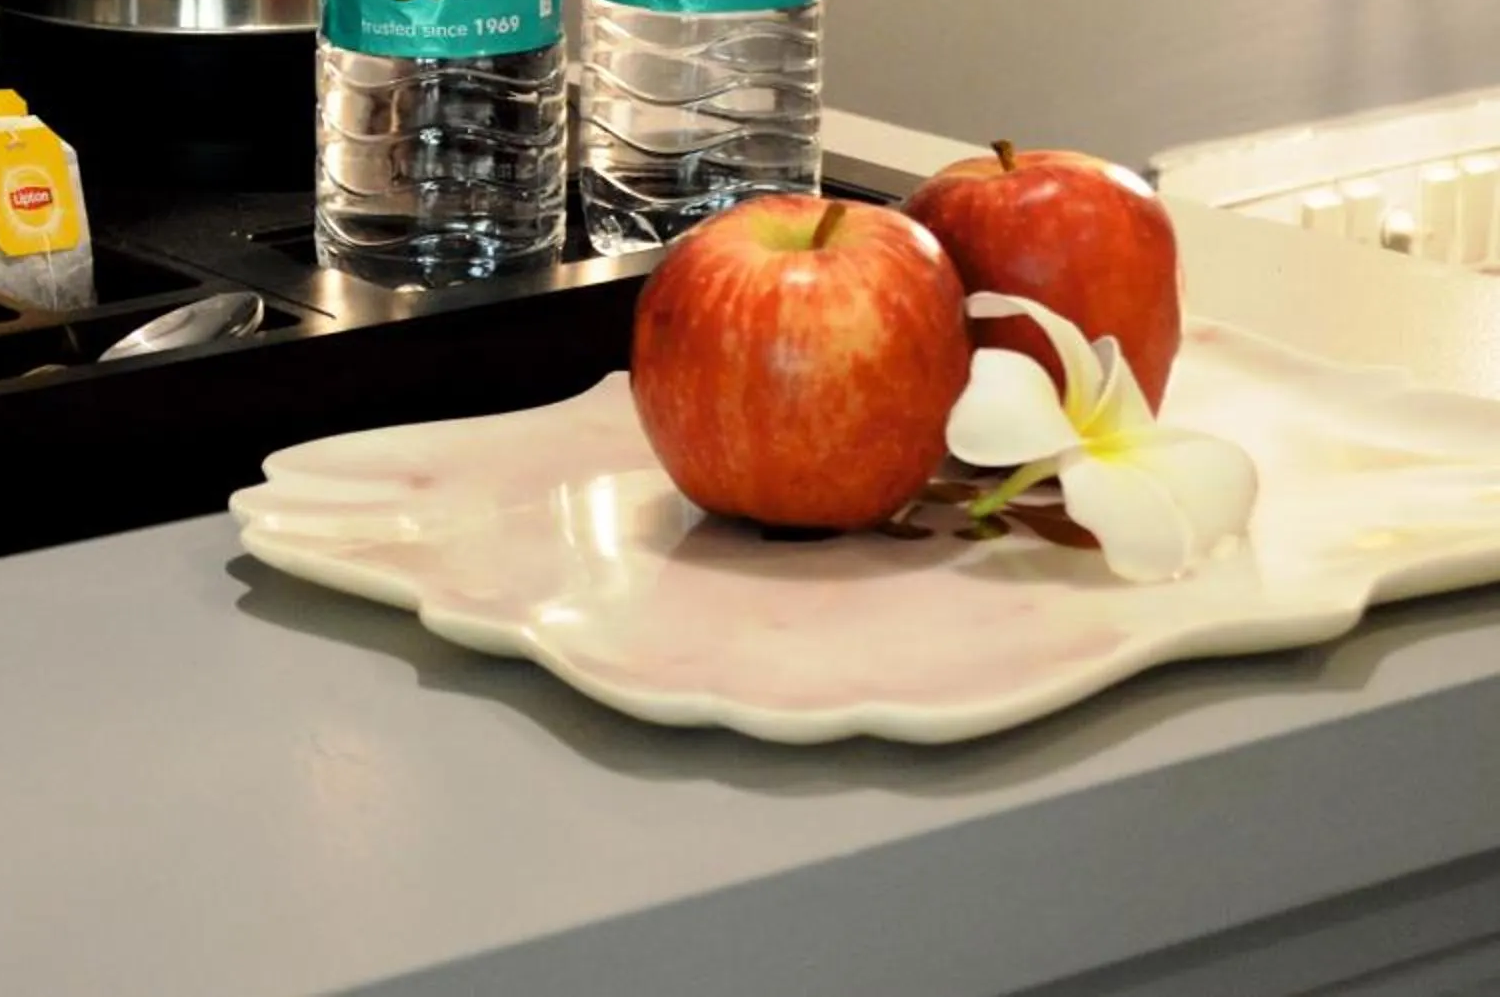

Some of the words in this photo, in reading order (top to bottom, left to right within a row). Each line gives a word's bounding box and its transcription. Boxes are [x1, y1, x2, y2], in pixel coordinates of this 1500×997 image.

[361, 17, 417, 38] trusted
[422, 22, 469, 39] since
[473, 14, 521, 36] 1969
[13, 191, 50, 208] Lipton
